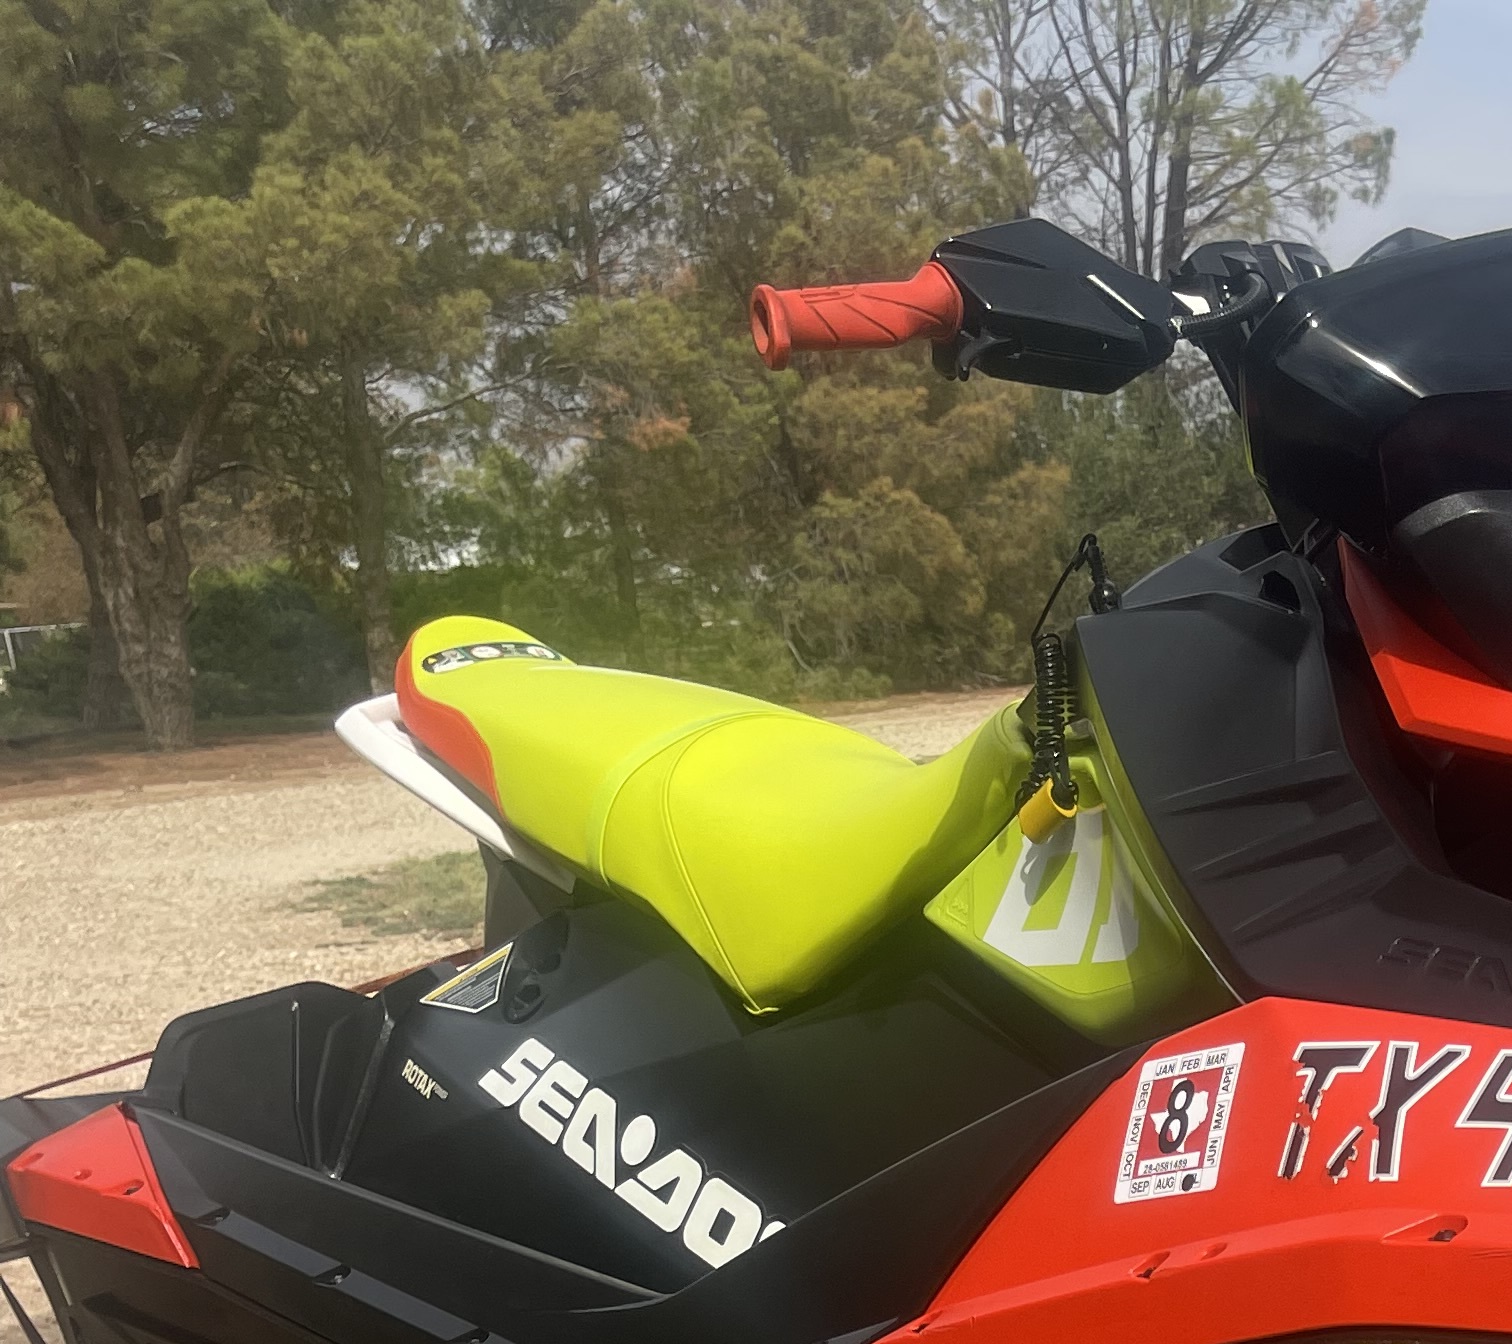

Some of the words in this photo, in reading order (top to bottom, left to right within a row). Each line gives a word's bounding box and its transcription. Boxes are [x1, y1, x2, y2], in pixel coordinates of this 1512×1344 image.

[1155, 1064, 1176, 1077] JAN
[1181, 1058, 1201, 1072] FEB
[1206, 1052, 1227, 1067] MAR
[401, 1058, 437, 1100] ROTAX
[1221, 1066, 1234, 1092] APR
[1137, 1082, 1151, 1109] DEC
[1158, 1079, 1195, 1154] 8
[1213, 1103, 1226, 1130] MAY
[1278, 1041, 1471, 1184] TX
[1130, 1117, 1142, 1143] NOV
[1206, 1139, 1219, 1165] JUN
[1122, 1153, 1135, 1178] OCT
[1130, 1179, 1150, 1194] SEP
[1155, 1176, 1175, 1190] AUG
